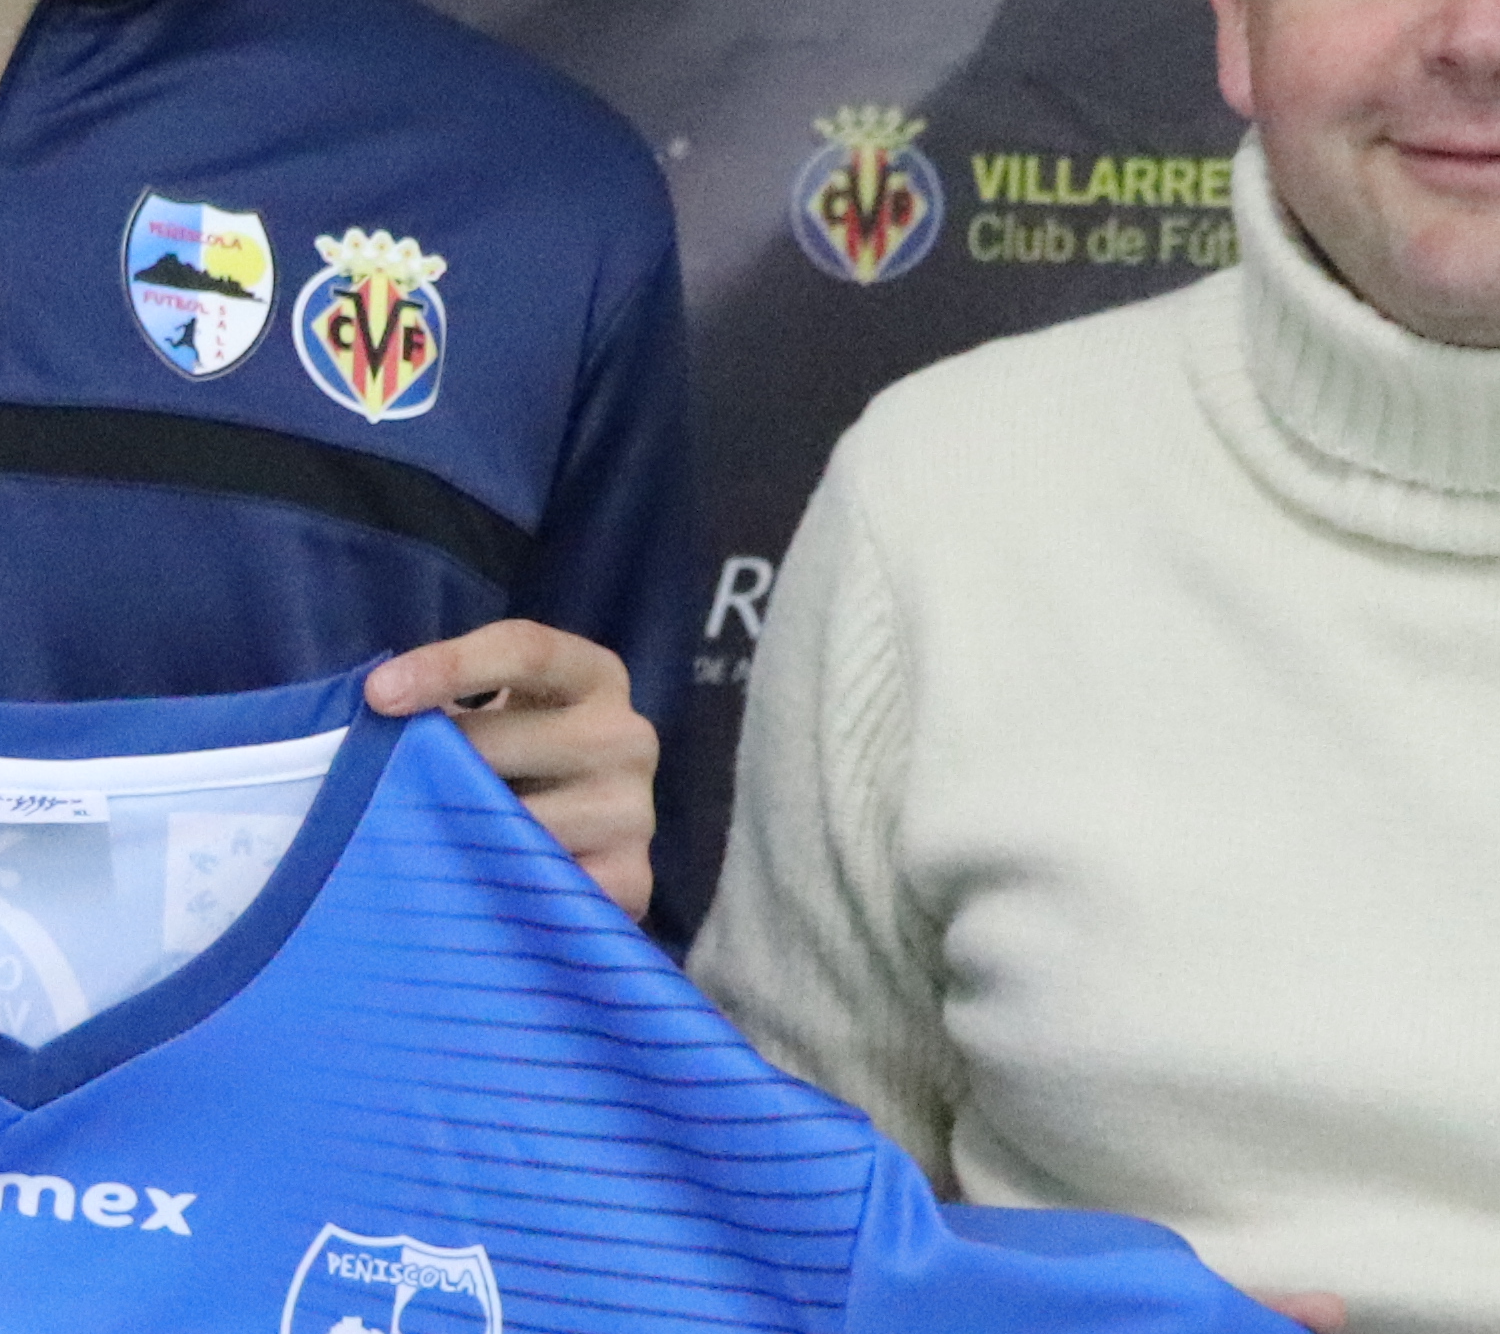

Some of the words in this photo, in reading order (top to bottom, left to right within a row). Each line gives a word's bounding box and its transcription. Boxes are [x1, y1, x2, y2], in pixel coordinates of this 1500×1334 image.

[971, 152, 1233, 209] VILLARRE
[967, 212, 1074, 264] Club
[1087, 221, 1146, 264] de
[326, 1252, 477, 1297] PEÑISCOLA
